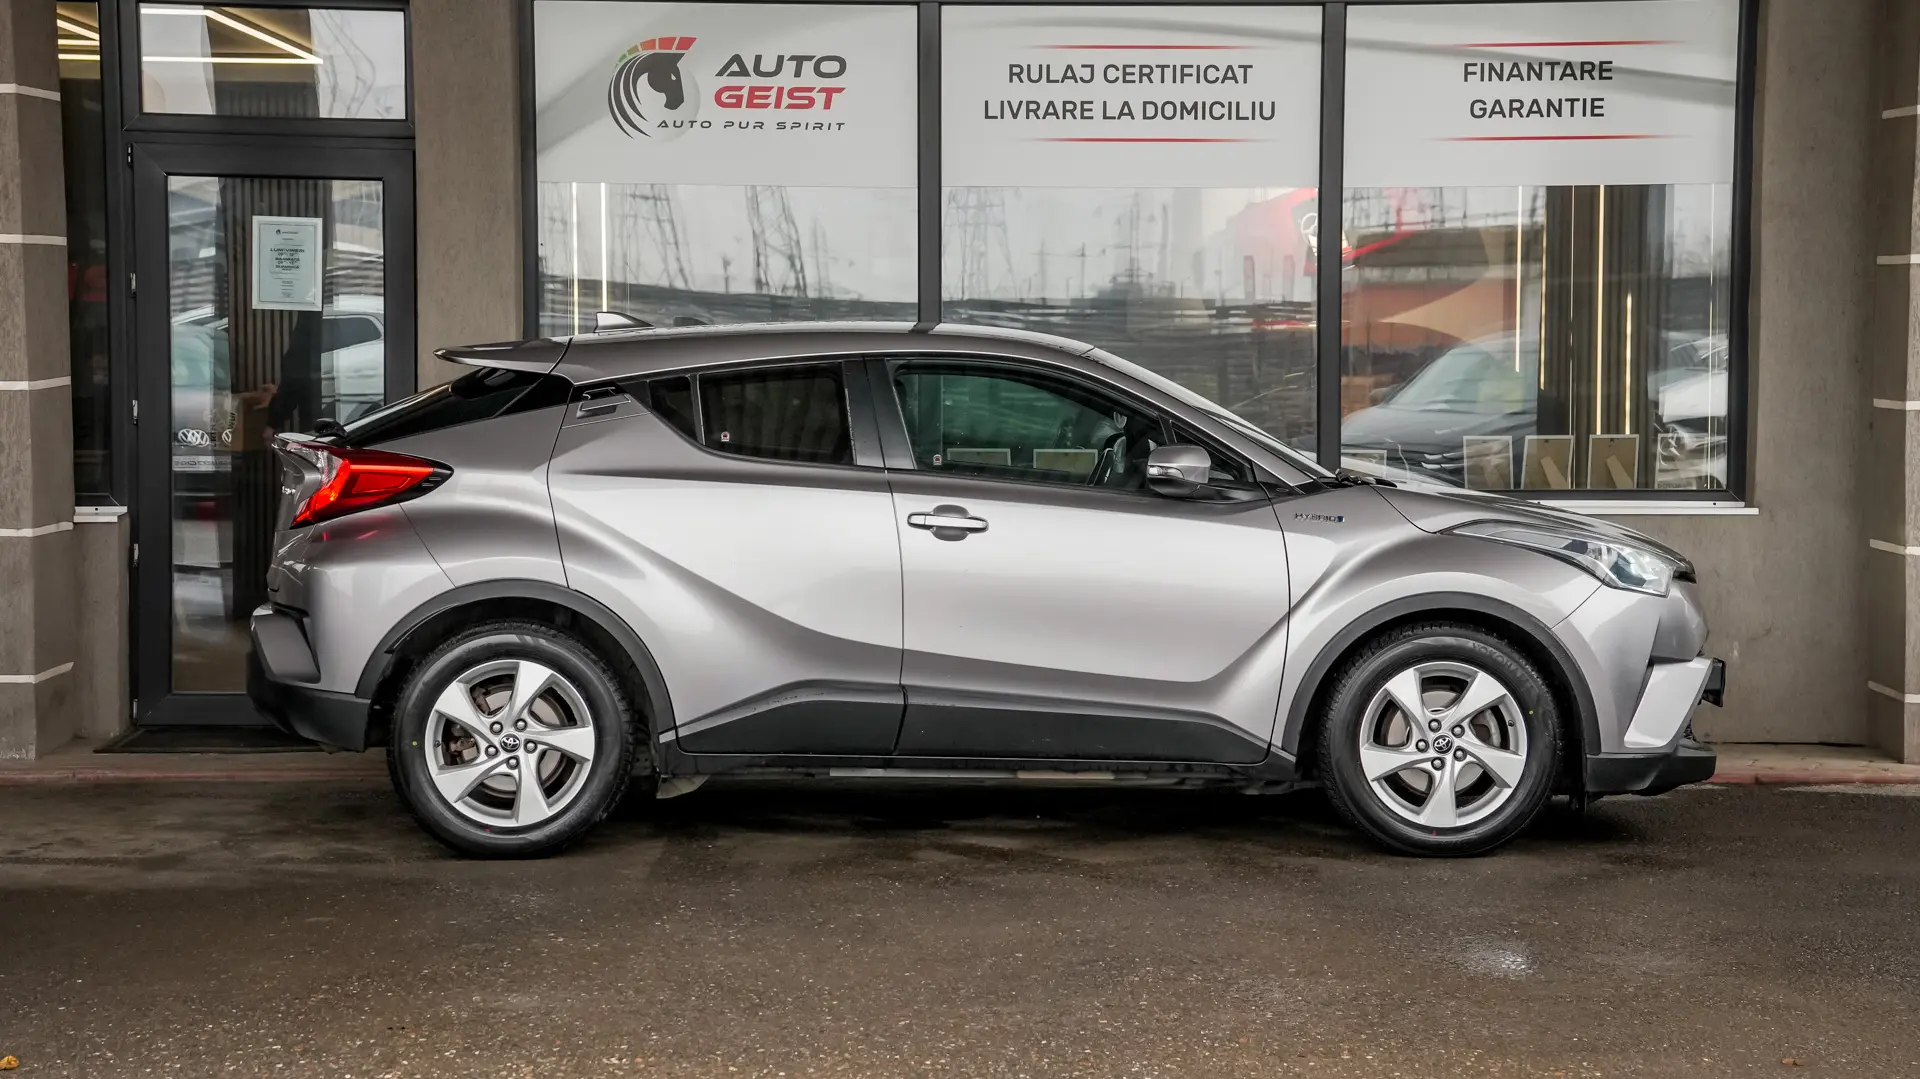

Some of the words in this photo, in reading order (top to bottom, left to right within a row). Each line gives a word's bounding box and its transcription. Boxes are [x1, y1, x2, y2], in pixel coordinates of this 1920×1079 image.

[714, 53, 847, 78] AUTO
[1008, 63, 1095, 84] RULAJ
[1103, 64, 1253, 84] CERTIFICAT
[1463, 61, 1613, 82] FINANTARE
[714, 85, 846, 110] GEIST
[1469, 97, 1605, 119] GARANTIE
[984, 100, 1094, 120] LIVRARE
[1102, 100, 1135, 120] LA
[1142, 100, 1276, 121] DOMICILIU
[657, 119, 712, 129] AUTO
[723, 120, 765, 130] PUR
[776, 121, 846, 131] SPIRIT
